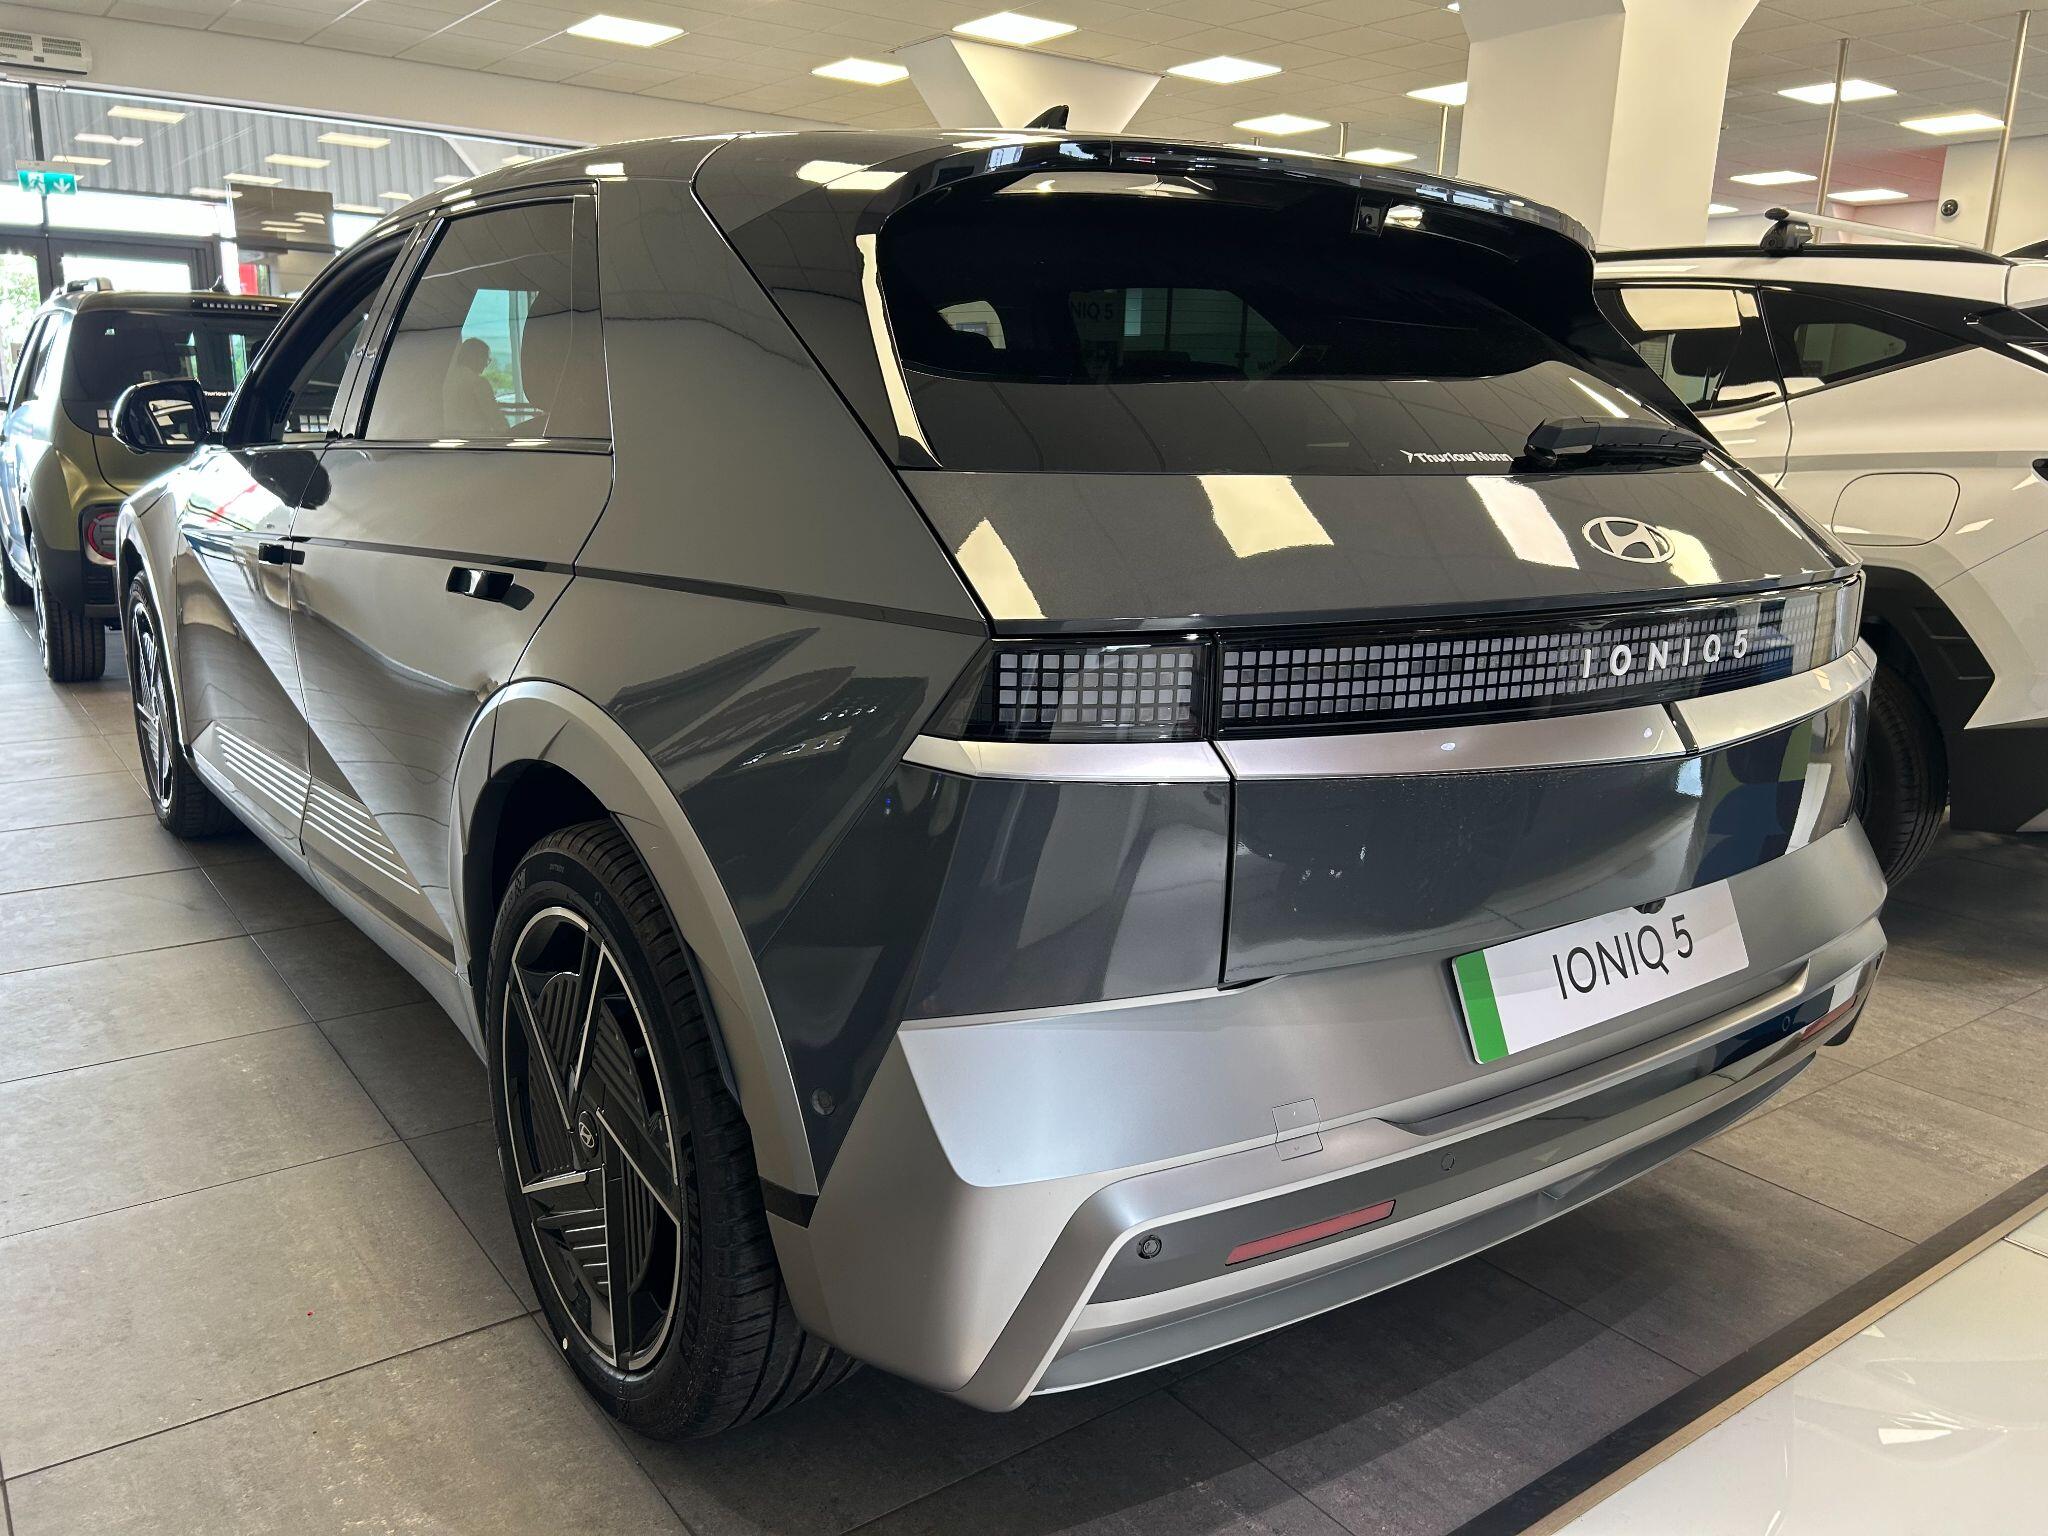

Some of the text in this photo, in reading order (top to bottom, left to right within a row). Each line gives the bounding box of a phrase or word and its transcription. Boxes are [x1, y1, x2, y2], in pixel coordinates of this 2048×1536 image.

[1071, 301, 1101, 322] NIQ
[1413, 451, 1515, 463] Thurlow Nunn
[1552, 913, 1694, 1000] IONIQ 5
